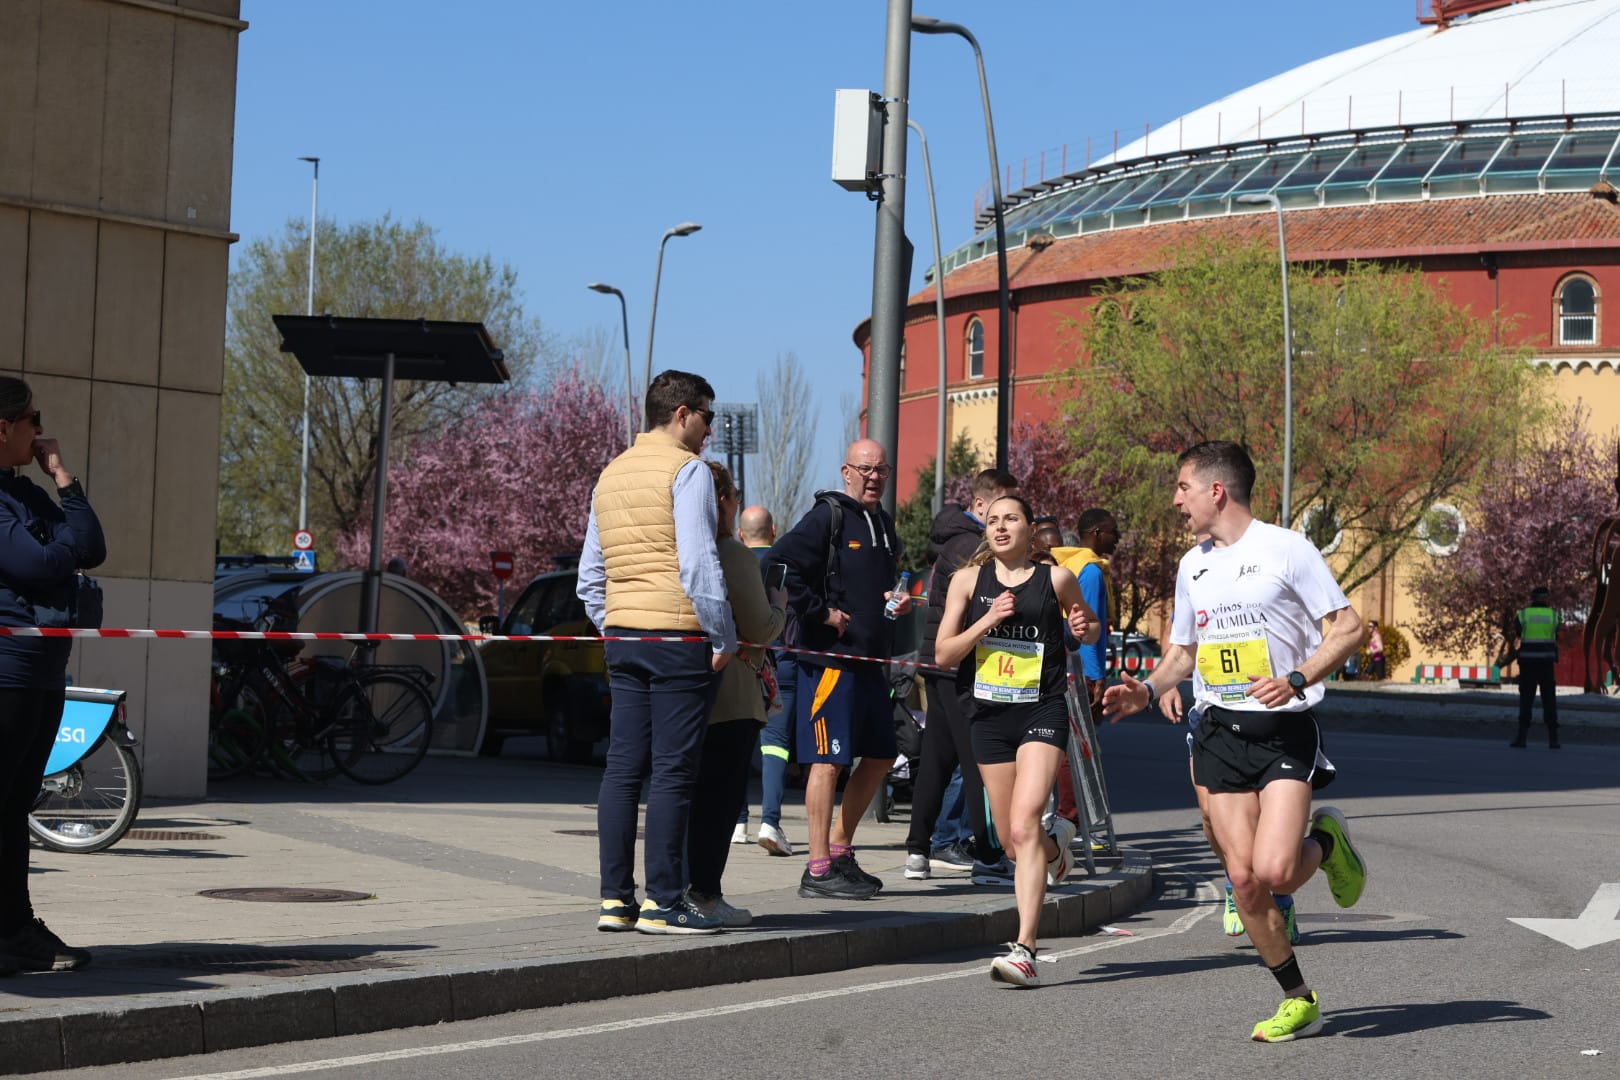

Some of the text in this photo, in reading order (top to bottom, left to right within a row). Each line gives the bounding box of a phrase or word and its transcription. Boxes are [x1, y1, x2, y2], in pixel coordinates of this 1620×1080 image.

[1212, 602, 1242, 616] vinos
[998, 655, 1015, 678] 14
[1220, 649, 1240, 673] 61
[56, 727, 85, 743] sa
